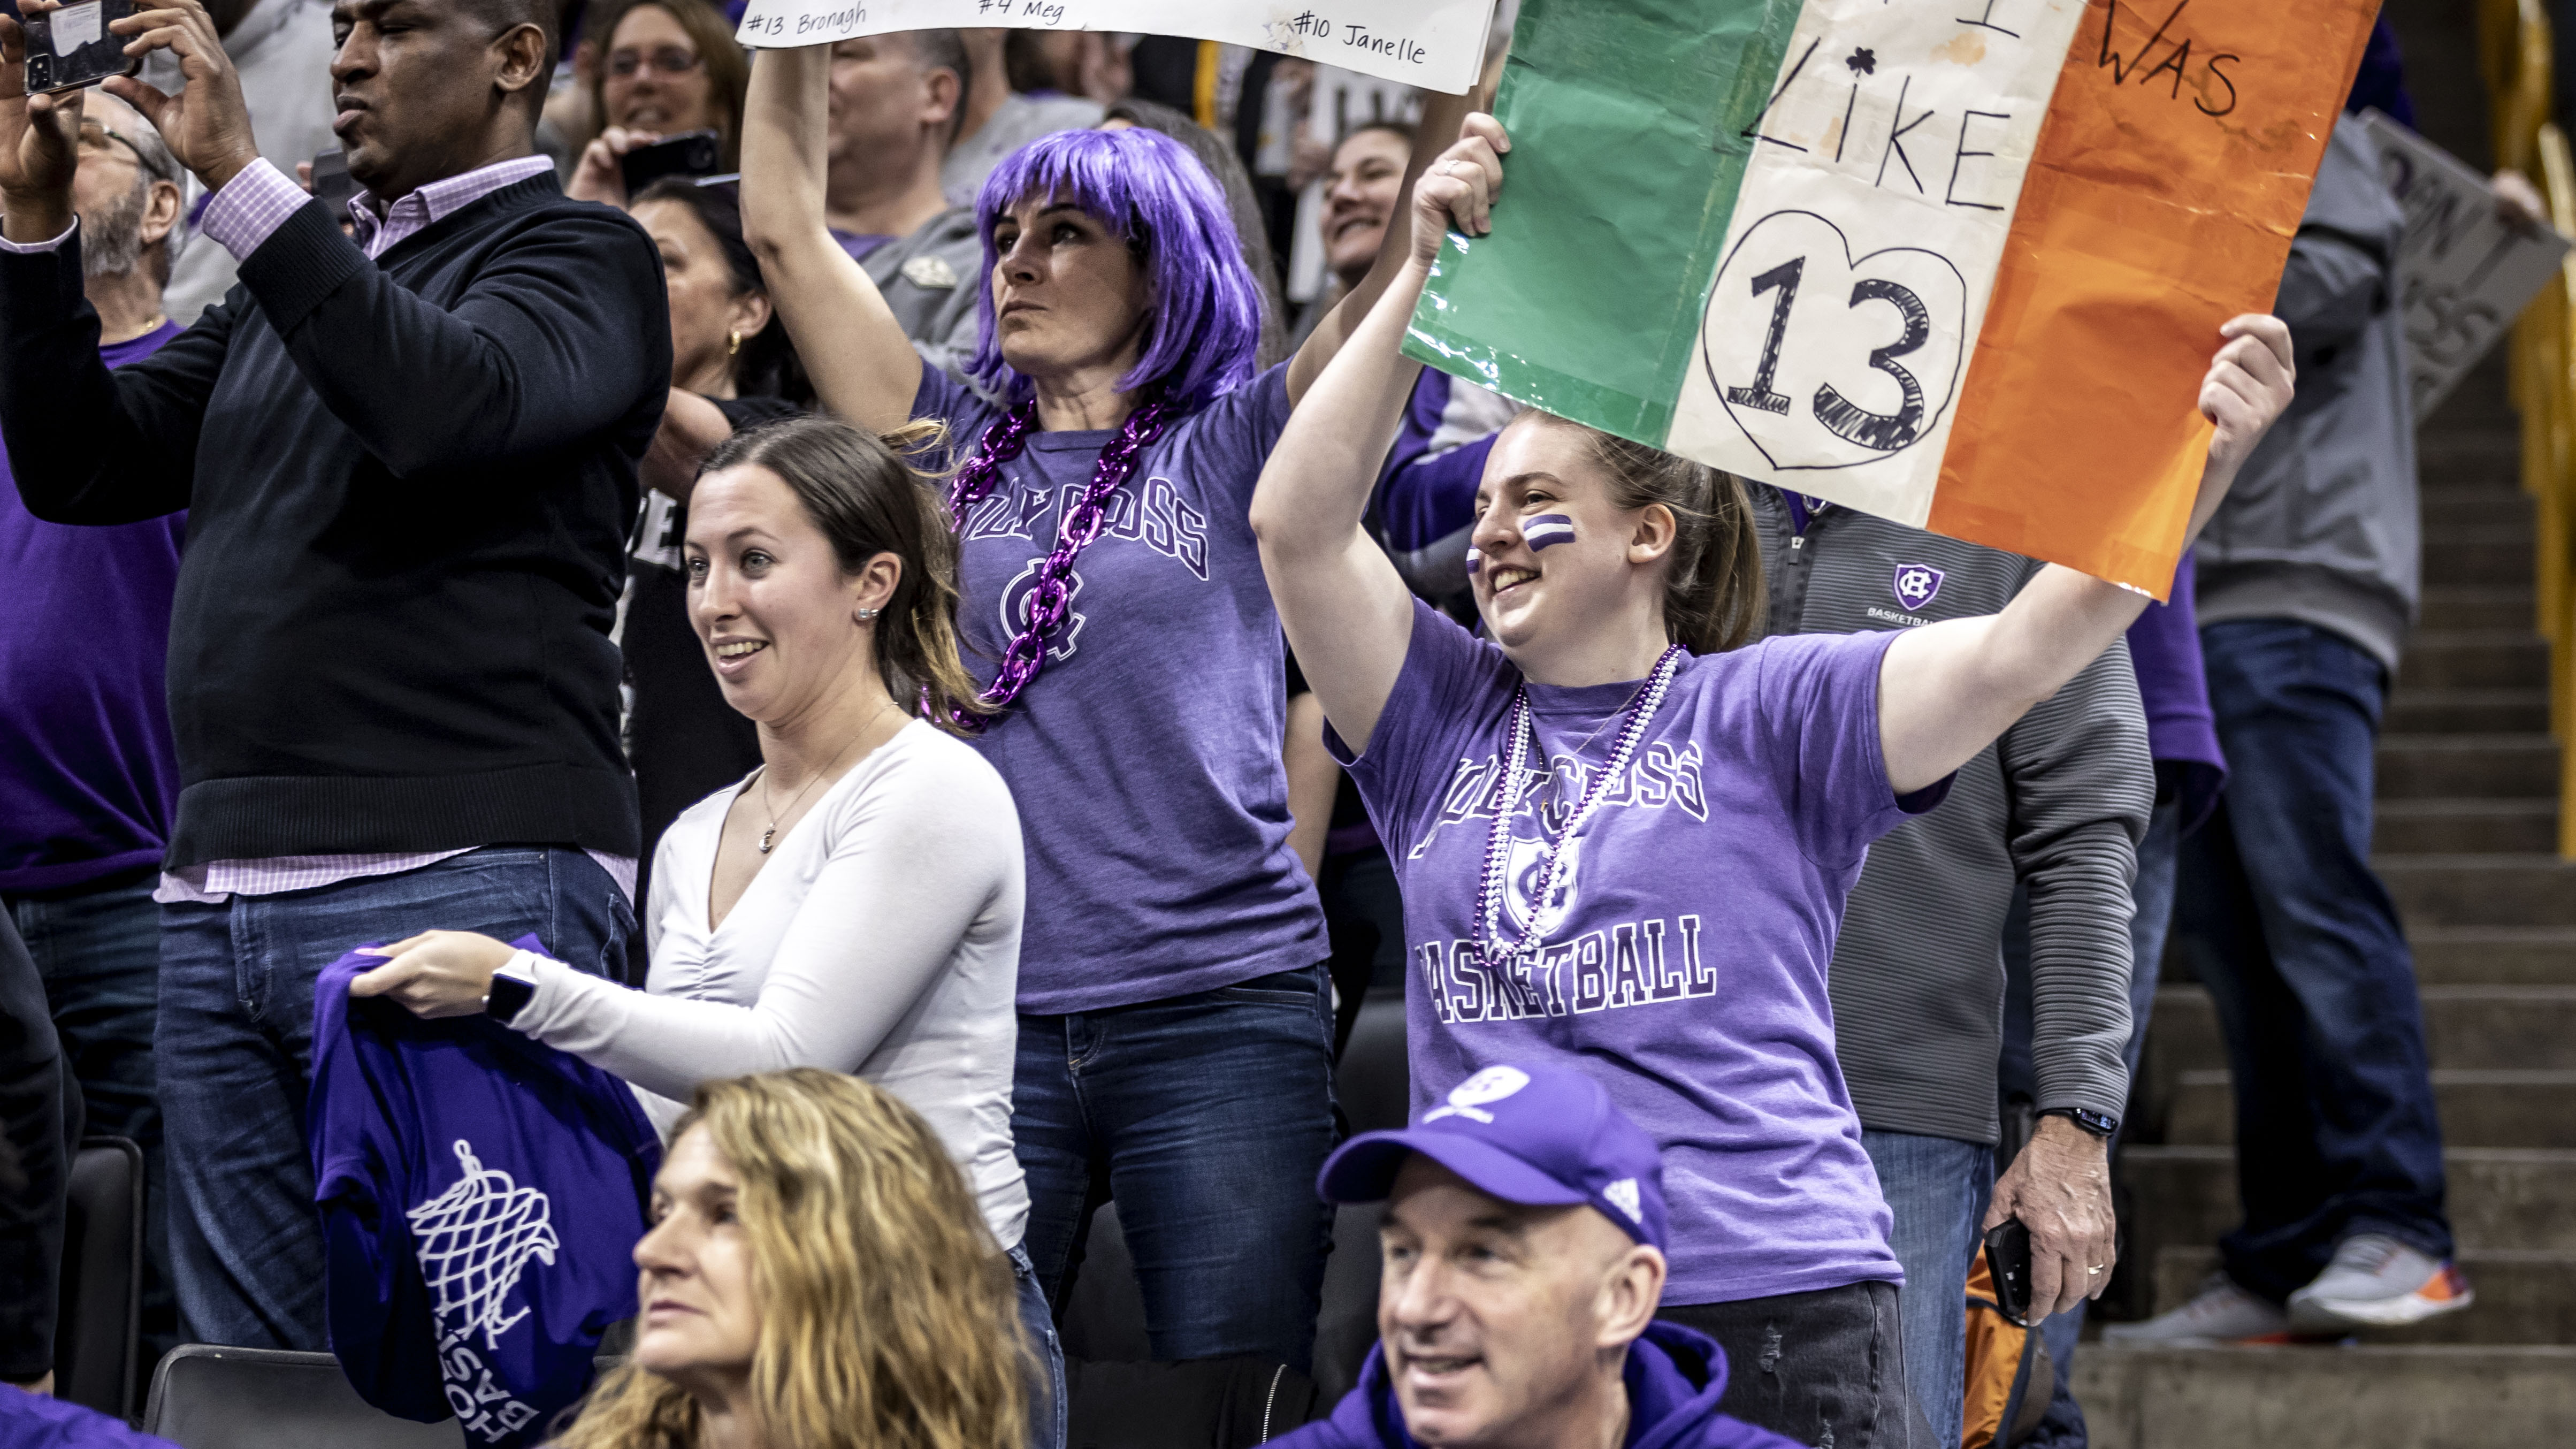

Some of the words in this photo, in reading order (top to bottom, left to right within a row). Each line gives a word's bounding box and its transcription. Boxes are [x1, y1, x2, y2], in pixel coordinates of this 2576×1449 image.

[747, 14, 784, 35] #13
[797, 1, 866, 34] Bronagh
[979, 0, 1011, 14] #4
[1022, 2, 1065, 26] Meg
[1293, 10, 1331, 37] #10
[1343, 25, 1426, 64] Janelle
[2099, 0, 2241, 117] WAS
[1726, 255, 1929, 451] 13
[1866, 607, 1935, 627] BASKETBA
[1408, 754, 1553, 859] OLY
[1414, 914, 1717, 1024] ASKETBALL
